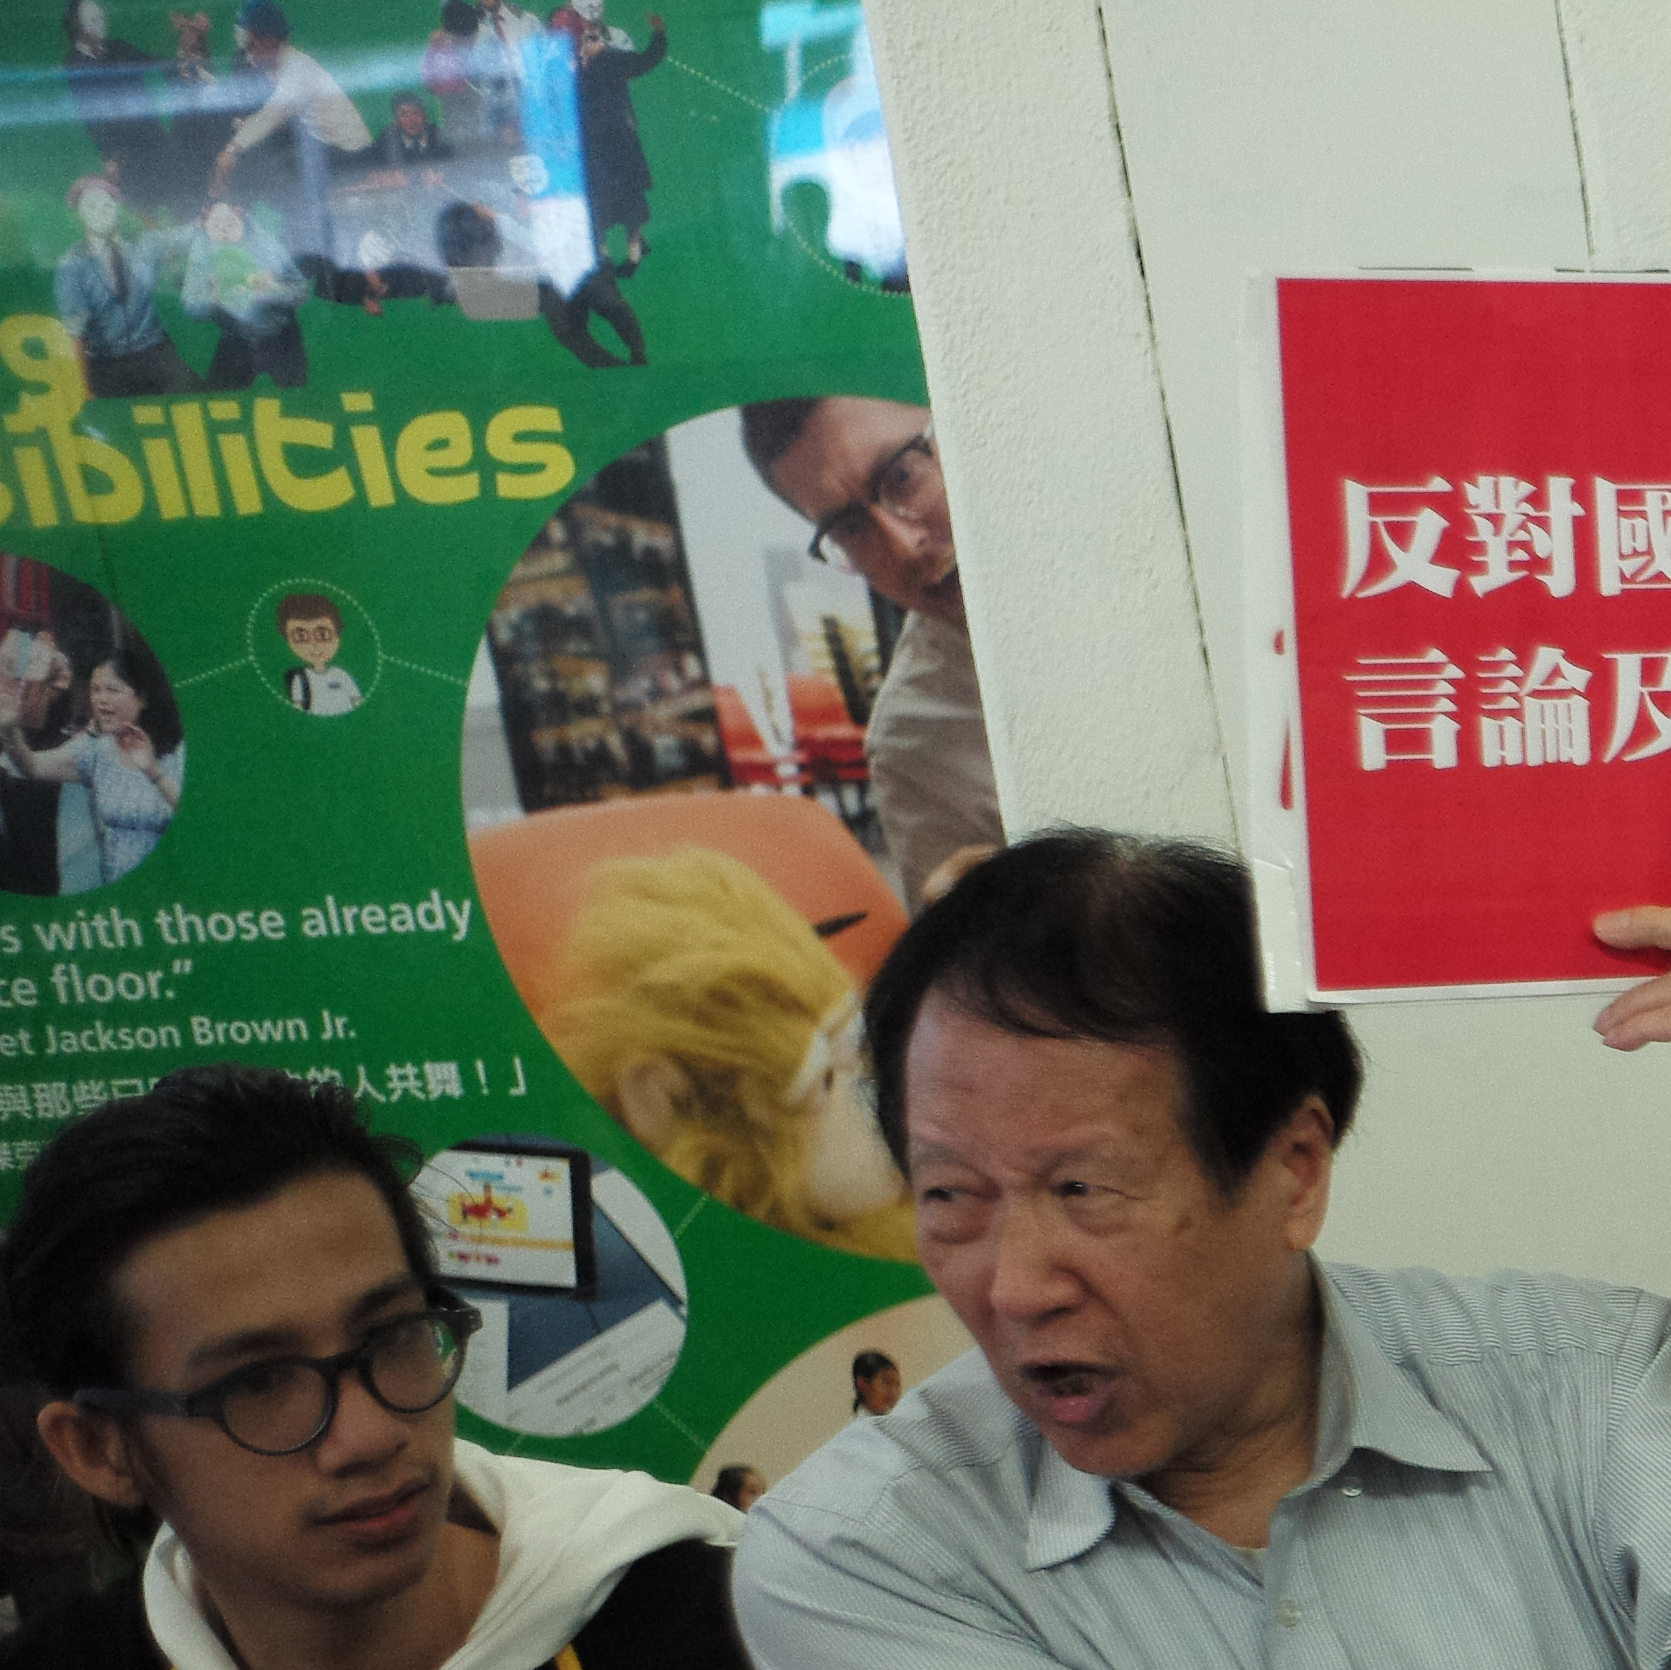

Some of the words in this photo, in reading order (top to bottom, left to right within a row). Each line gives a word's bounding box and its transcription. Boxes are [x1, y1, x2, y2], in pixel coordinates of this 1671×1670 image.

[0, 391, 576, 528] ibilities
[34, 908, 143, 952] with
[155, 903, 287, 944] those
[302, 889, 472, 942] already
[45, 1020, 181, 1055] Jackson
[191, 1013, 309, 1047] Brown
[321, 1010, 356, 1040] Jr.
